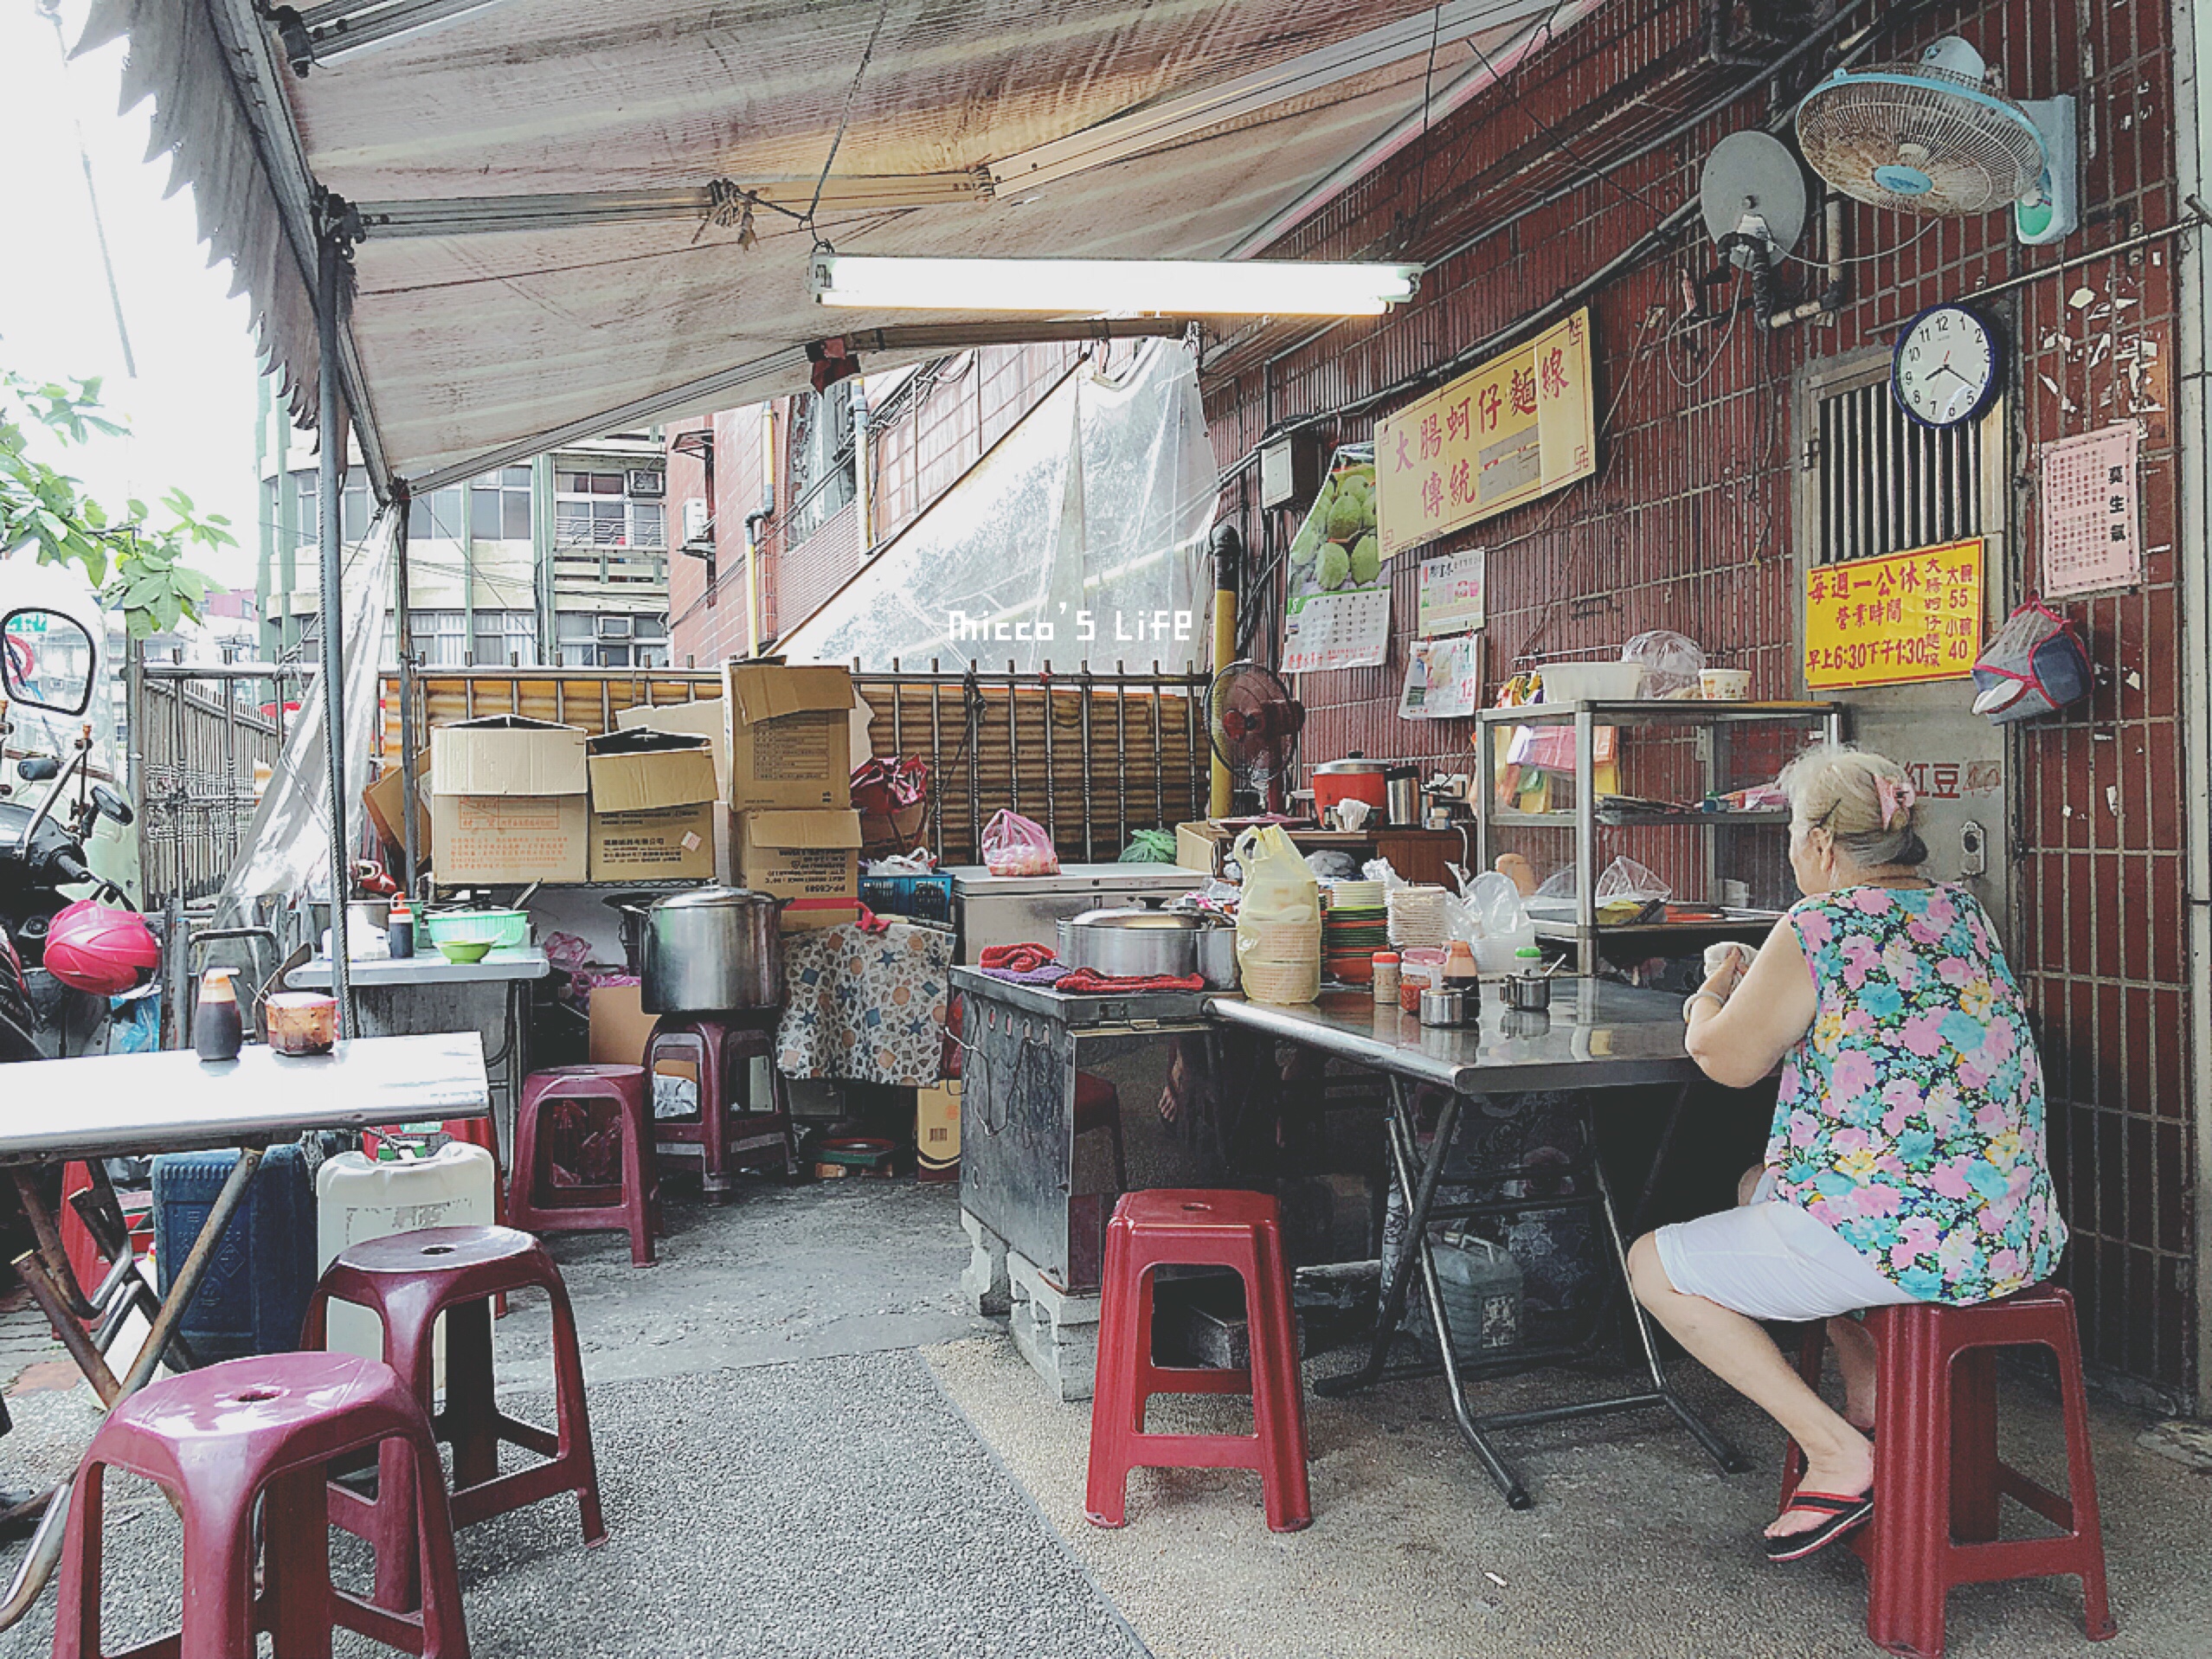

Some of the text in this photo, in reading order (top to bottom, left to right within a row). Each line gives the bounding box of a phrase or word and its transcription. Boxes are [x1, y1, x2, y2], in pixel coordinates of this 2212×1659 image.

[1935, 316, 1949, 332] 12
[1959, 316, 1966, 331] 1
[1919, 328, 1931, 343] 11
[1975, 328, 1984, 344] 2
[1909, 346, 1920, 362] 10
[1966, 389, 1975, 405] 5
[1395, 346, 1570, 473] 大腸蚵仔麵線
[1930, 400, 1938, 415] 7
[1421, 459, 1476, 519] 傳統
[1807, 560, 1922, 605] 每週一公休
[1949, 588, 1969, 609] 55
[1835, 597, 1903, 632] 營業時間
[1948, 640, 1969, 660] 40
